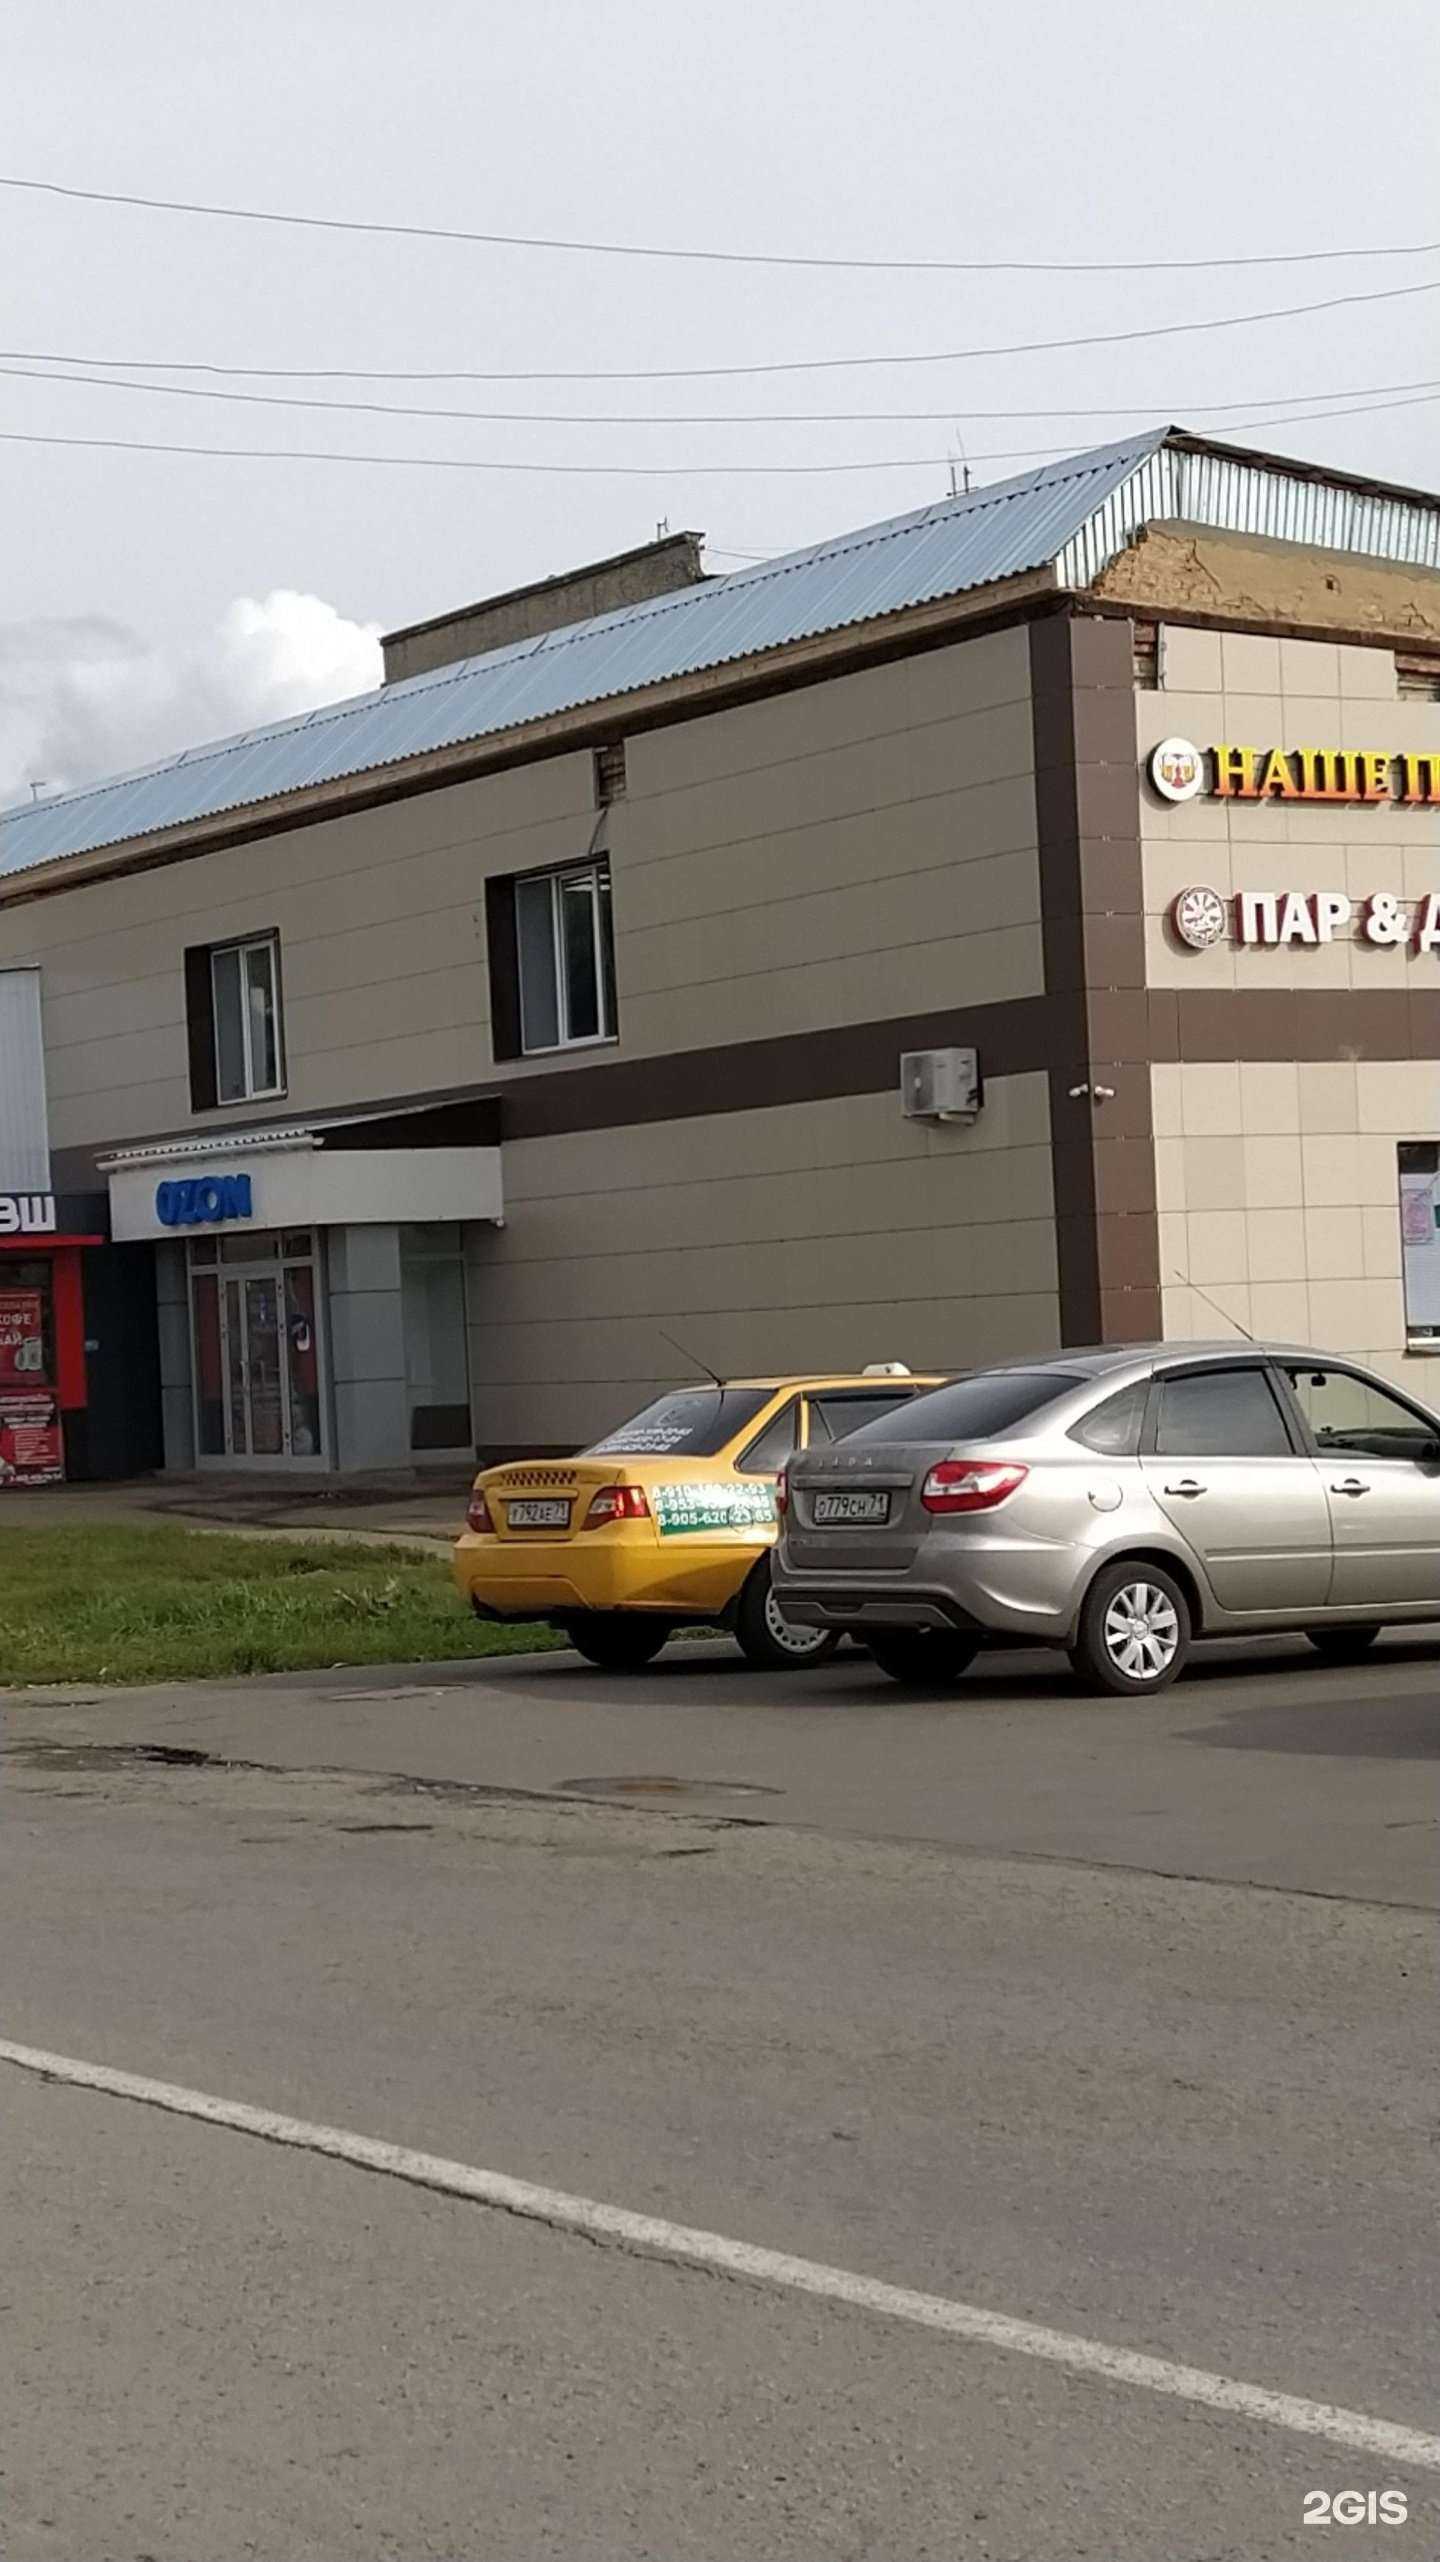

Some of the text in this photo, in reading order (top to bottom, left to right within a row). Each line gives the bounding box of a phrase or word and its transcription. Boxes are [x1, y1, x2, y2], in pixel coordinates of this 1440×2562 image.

[1210, 744, 1398, 803] НАШЕ
[1238, 891, 1350, 944] ПАР
[1365, 892, 1410, 945] &
[156, 1173, 252, 1226] OZON
